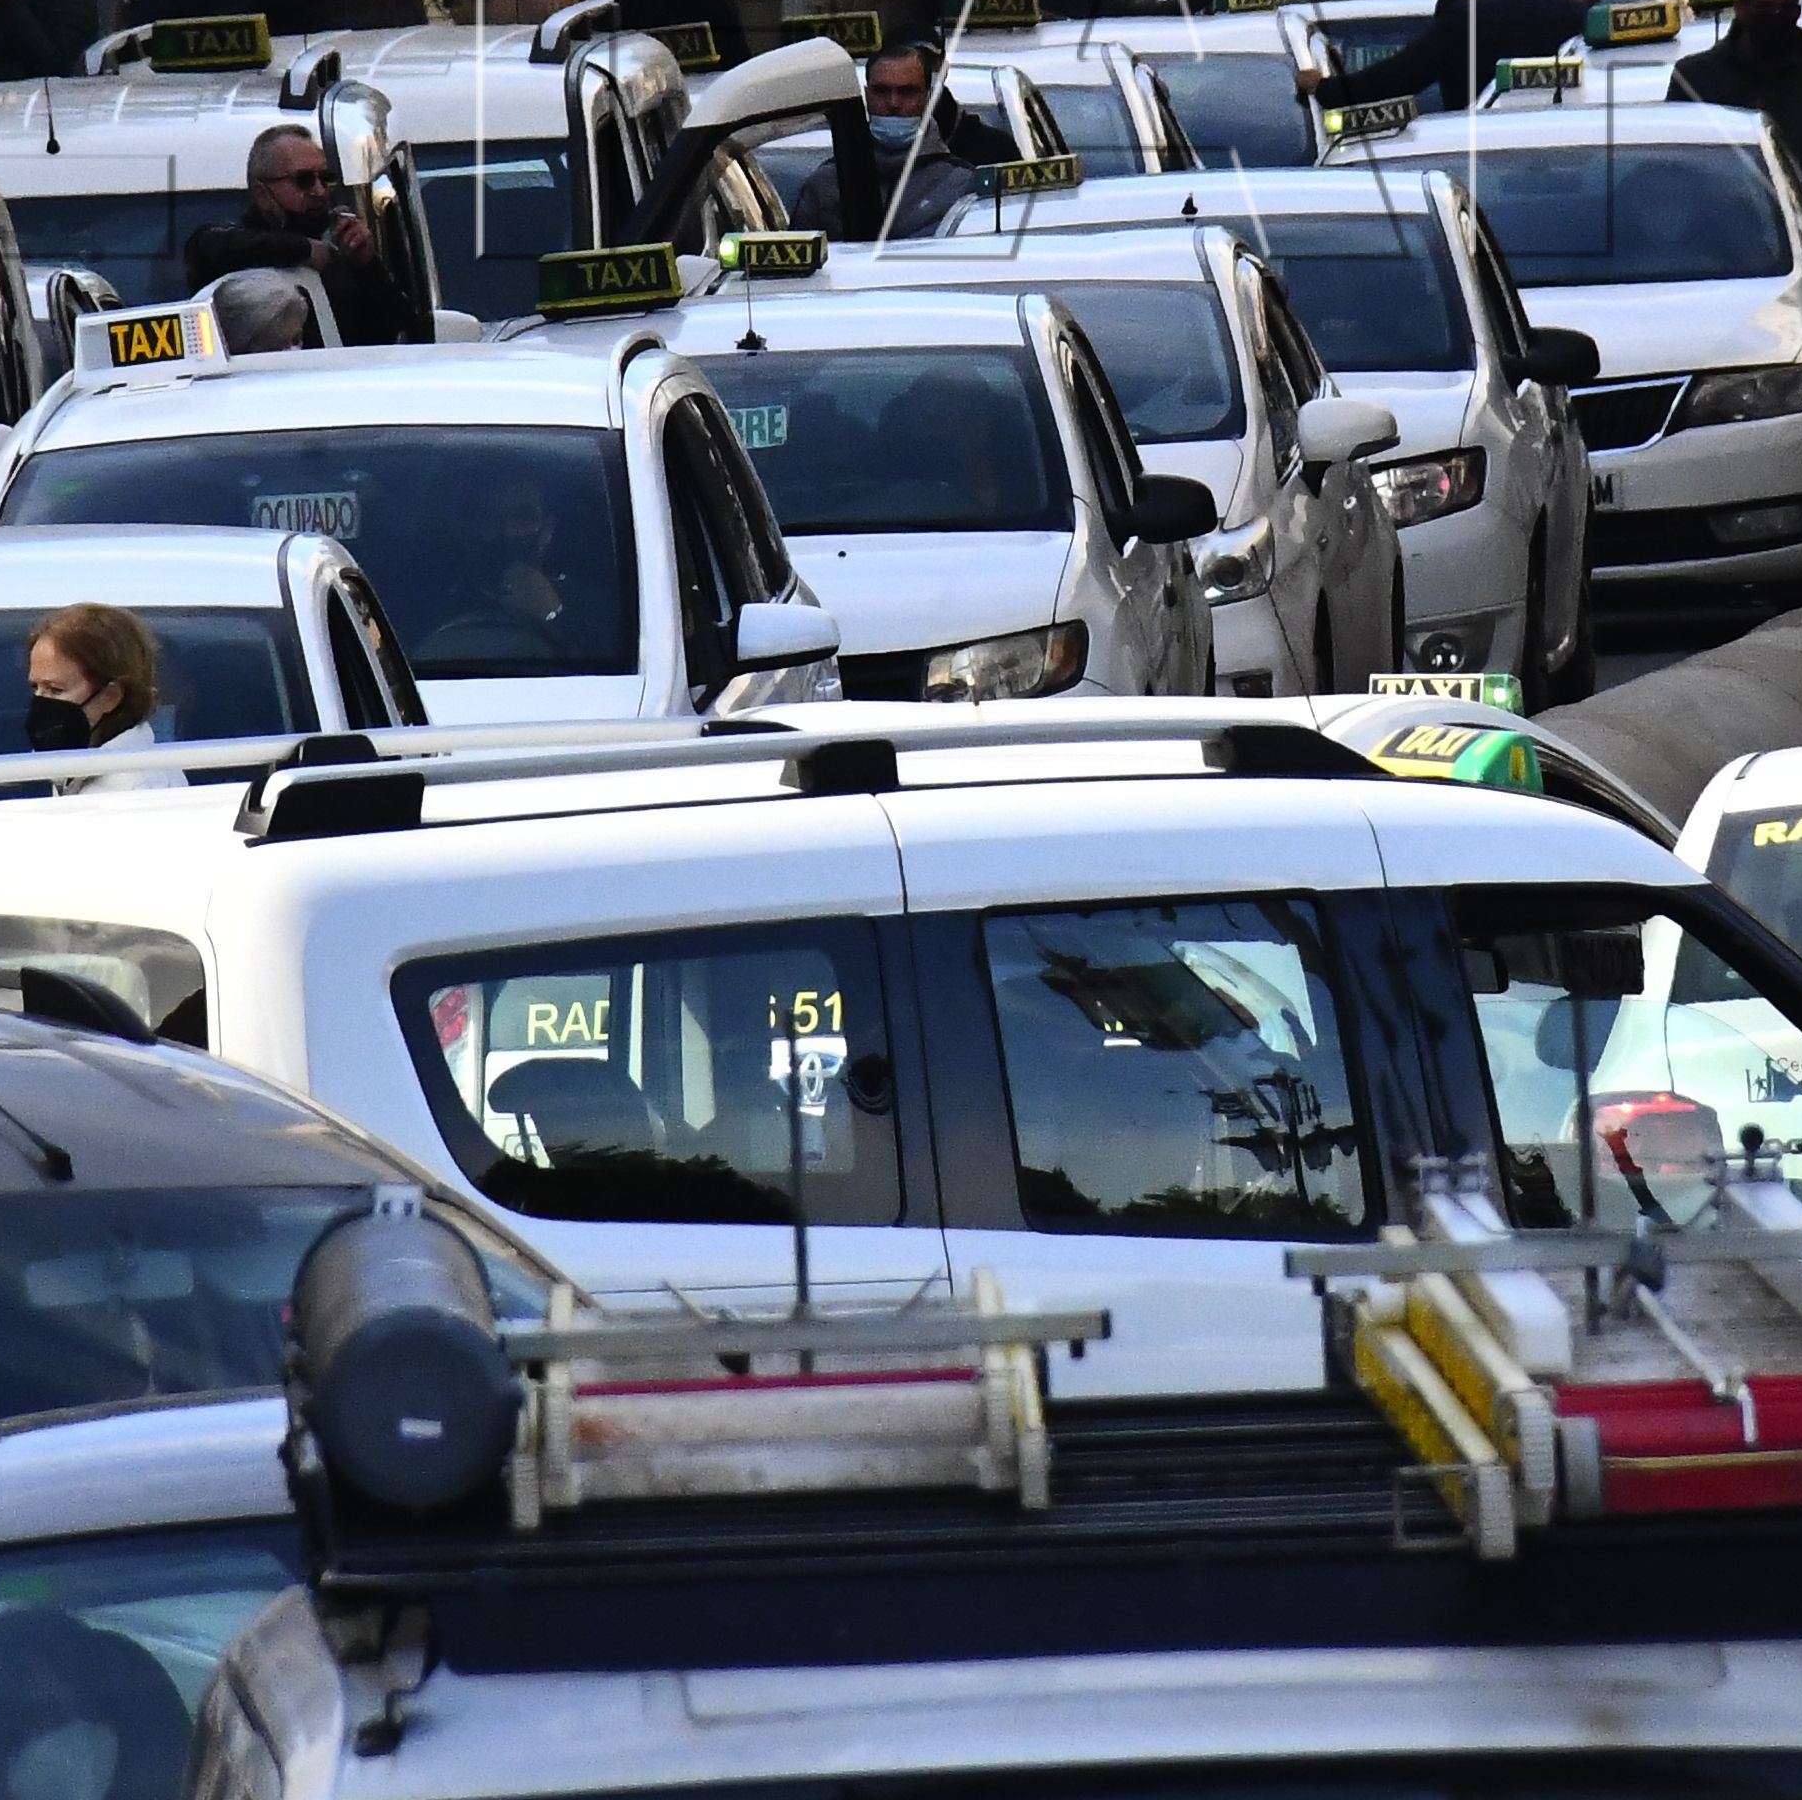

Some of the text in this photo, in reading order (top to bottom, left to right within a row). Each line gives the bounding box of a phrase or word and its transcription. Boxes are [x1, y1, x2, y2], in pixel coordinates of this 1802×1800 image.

[1615, 9, 1660, 27] TAXI
[181, 29, 253, 54] TAXI
[1515, 68, 1579, 87] TAXI
[1347, 104, 1405, 128] TAXI
[1004, 162, 1068, 187] TAXI
[745, 244, 814, 266] TAXI
[577, 256, 659, 290] TAXI
[110, 318, 185, 364] TAXI
[258, 497, 356, 538] OCUPADO
[1395, 726, 1478, 757] TAXI
